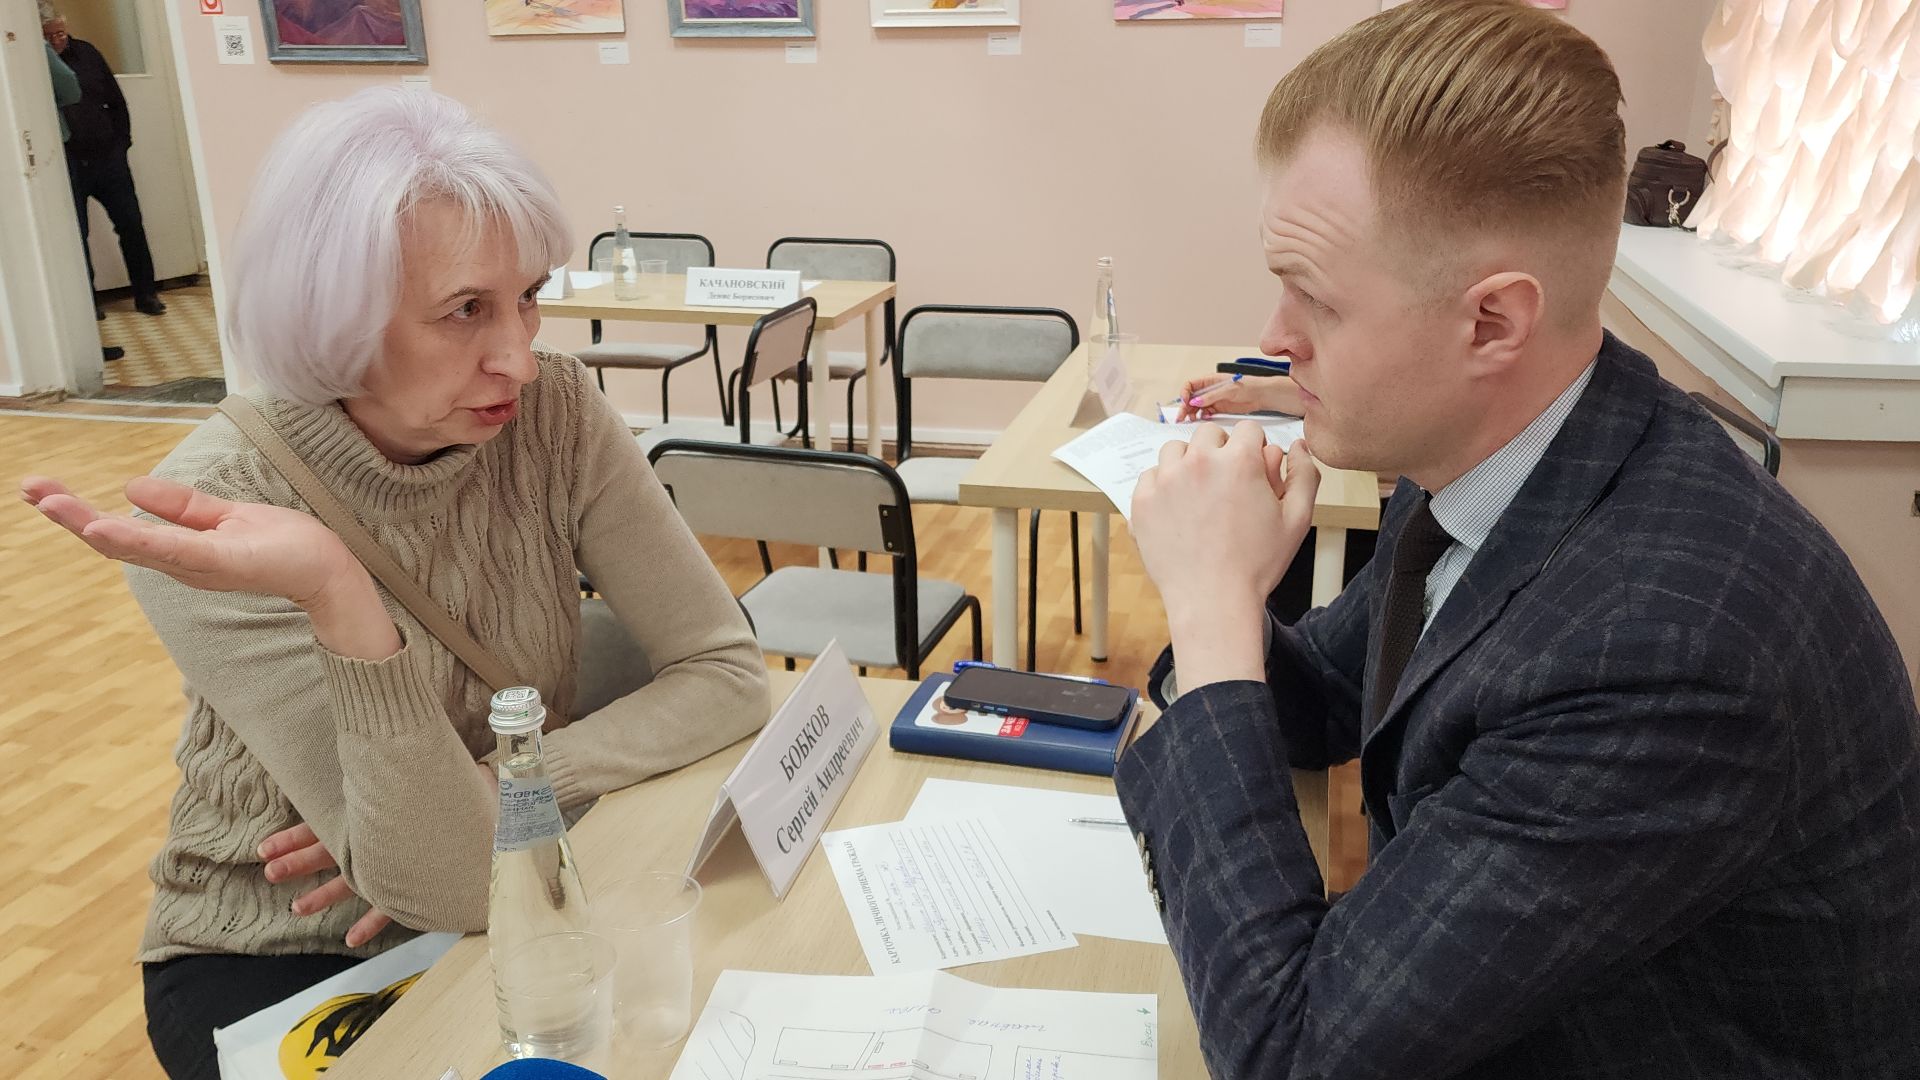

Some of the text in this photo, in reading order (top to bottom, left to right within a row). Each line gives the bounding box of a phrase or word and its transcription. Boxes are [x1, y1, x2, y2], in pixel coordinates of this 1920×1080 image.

[699, 279, 785, 290] КАЧАНОВСКИЙ
[733, 293, 775, 301] Борисович
[779, 704, 830, 783] БОБКОВ
[776, 717, 865, 855] Сергей Андреевич
[865, 893, 884, 926] ЛИЧНОГО
[880, 926, 902, 964] КАРТОЧКА
